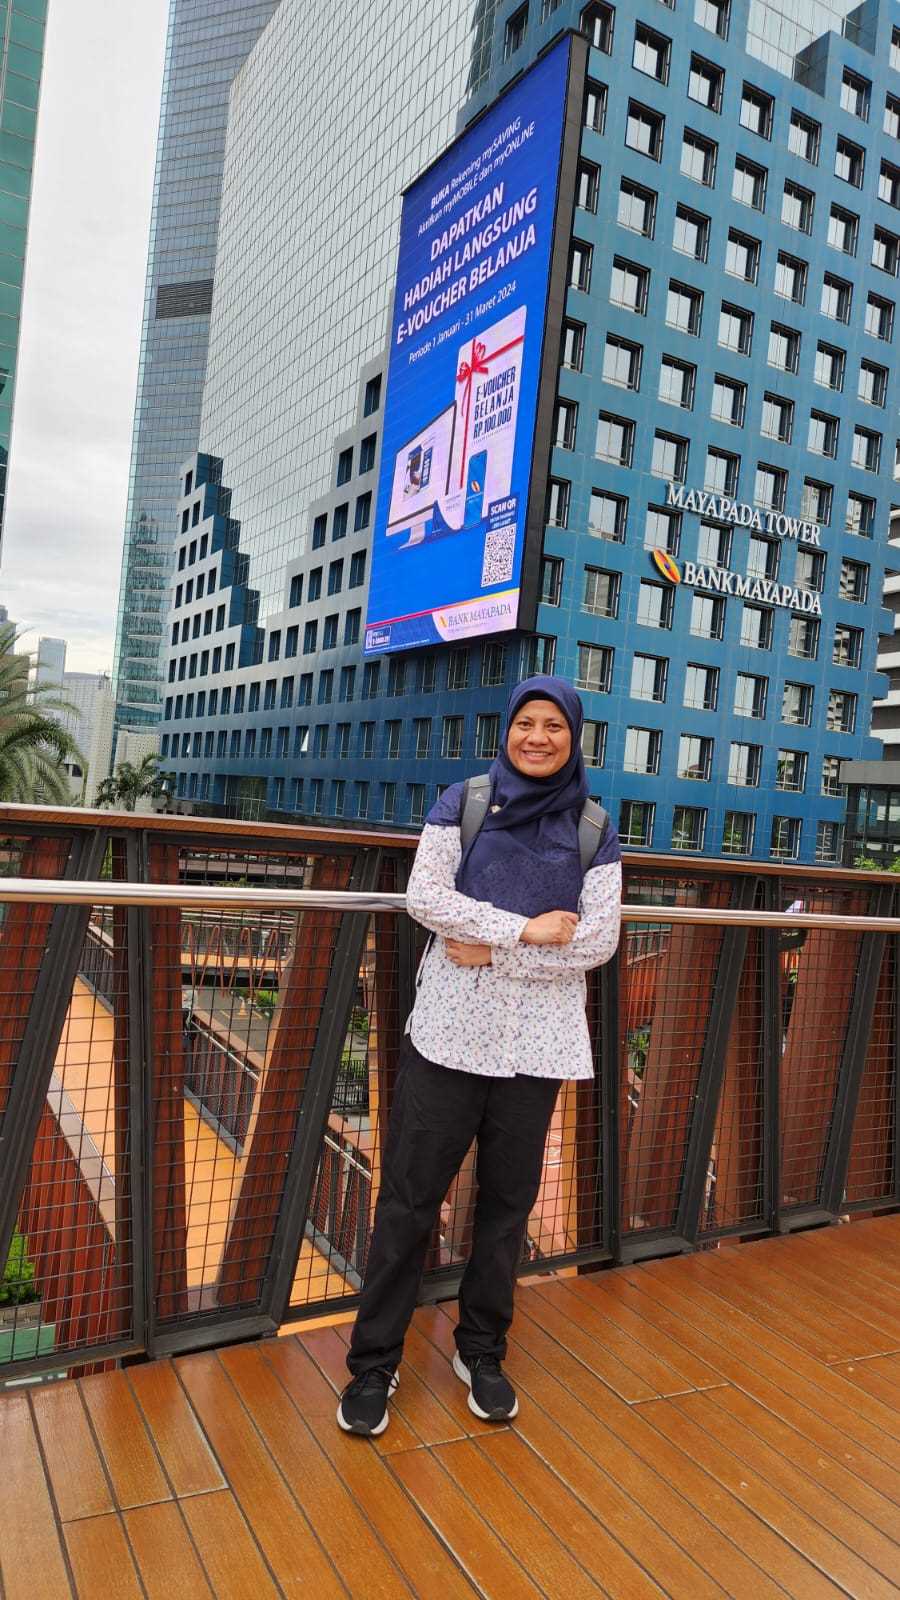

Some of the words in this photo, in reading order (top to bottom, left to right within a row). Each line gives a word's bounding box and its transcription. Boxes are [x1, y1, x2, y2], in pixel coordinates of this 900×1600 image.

[431, 184, 450, 210] BUKA
[451, 156, 481, 192] Rekening
[482, 116, 521, 162] mySAVING
[443, 173, 478, 216] myMOBILE
[480, 163, 493, 181] dan
[494, 121, 535, 166] myONLINE
[403, 258, 452, 312] HADIAH
[454, 187, 538, 272] LANGSUNG
[430, 181, 505, 261] DAPATKAN
[396, 275, 467, 345] E-VOUCHER
[469, 223, 537, 292] BELANJA
[409, 341, 432, 365] Periode
[437, 321, 461, 346] Januari
[465, 311, 474, 326] 31
[475, 294, 496, 319] Maret
[497, 280, 518, 304] 2024
[474, 385, 514, 421] BELANJA
[476, 366, 516, 402] E-VOUCHER
[490, 501, 507, 516] SCAN
[666, 482, 763, 531] MAYAPADA
[765, 511, 822, 547] TOWER
[448, 611, 470, 628] BANK
[470, 603, 512, 622] MAYAPADA
[683, 560, 735, 595] BANK
[735, 573, 823, 615] MAYAPADA
